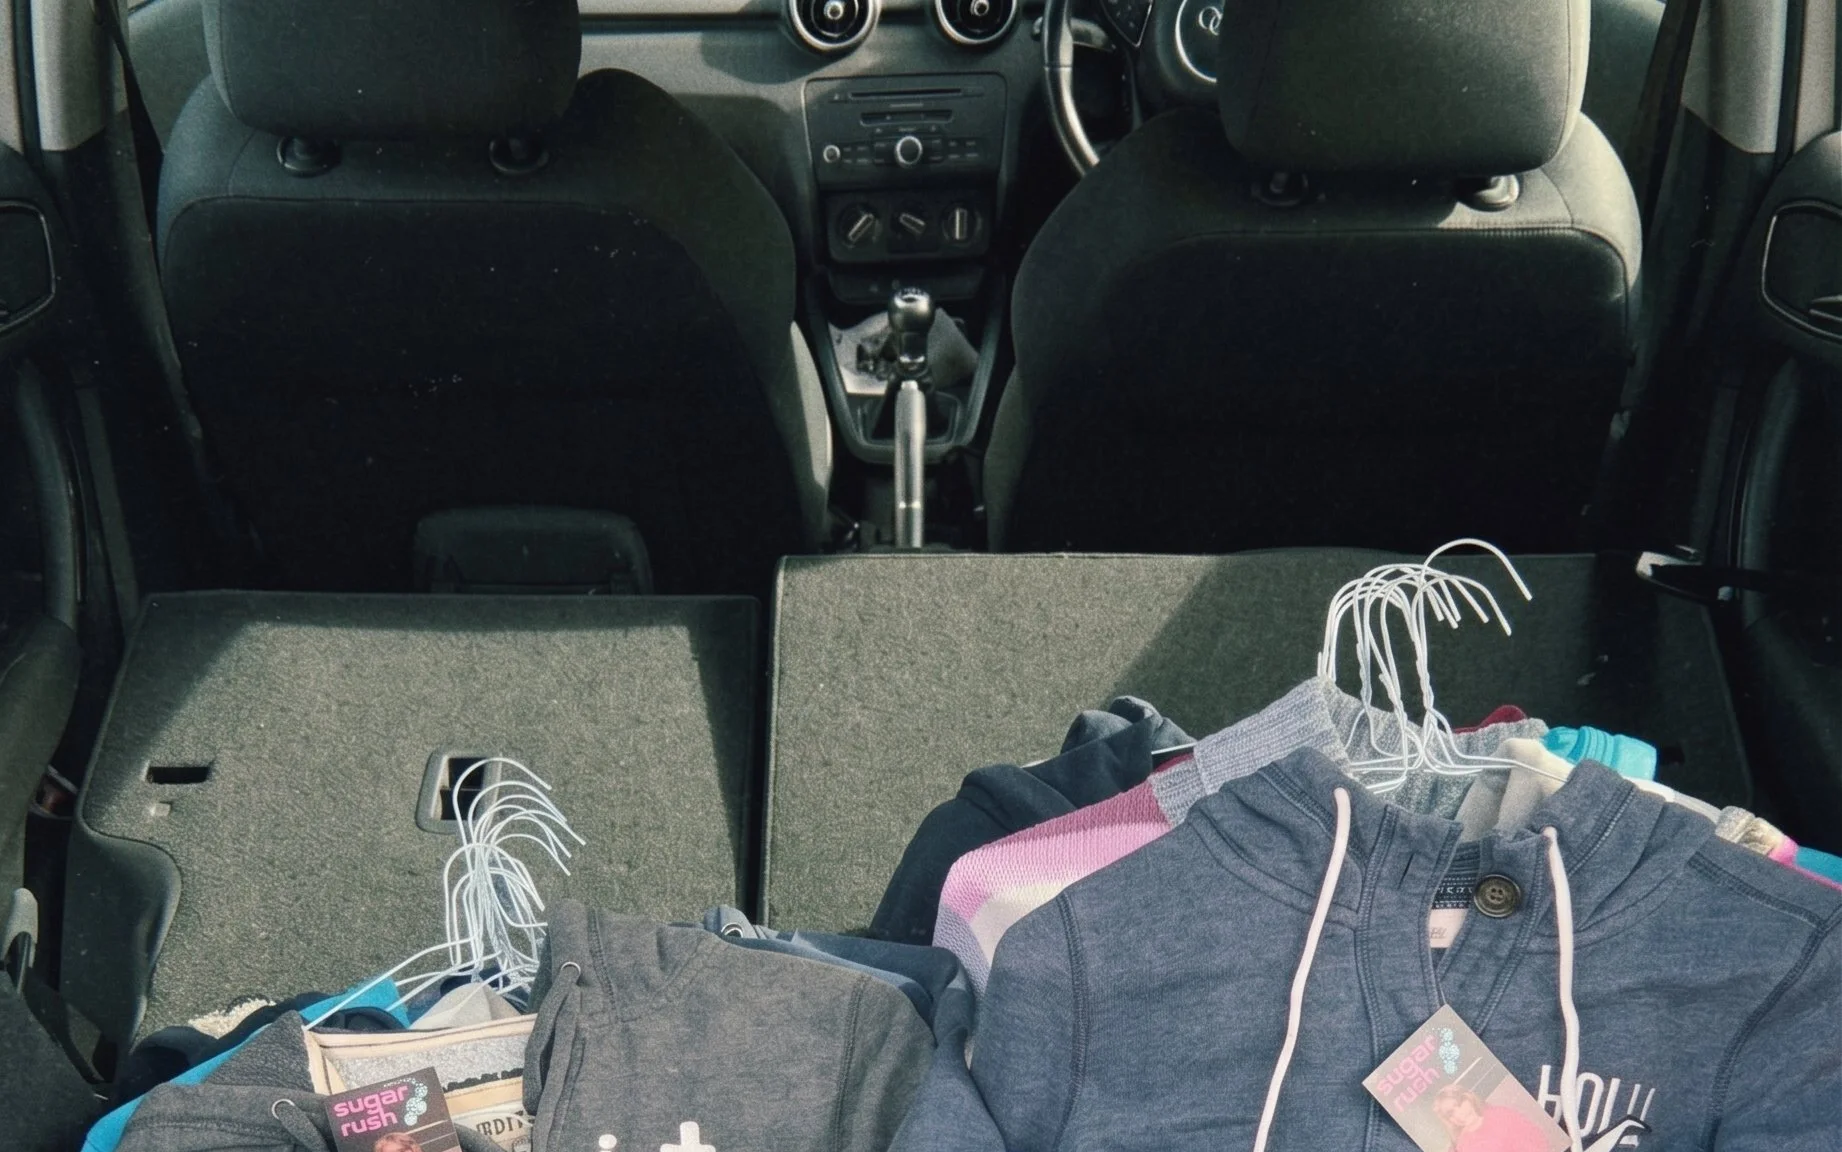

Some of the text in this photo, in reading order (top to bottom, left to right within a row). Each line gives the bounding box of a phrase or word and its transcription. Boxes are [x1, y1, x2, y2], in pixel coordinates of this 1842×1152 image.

[1376, 1034, 1437, 1096] sugar
[333, 1085, 409, 1118] sugar
[1394, 1064, 1440, 1113] rush
[341, 1101, 399, 1137] rush
